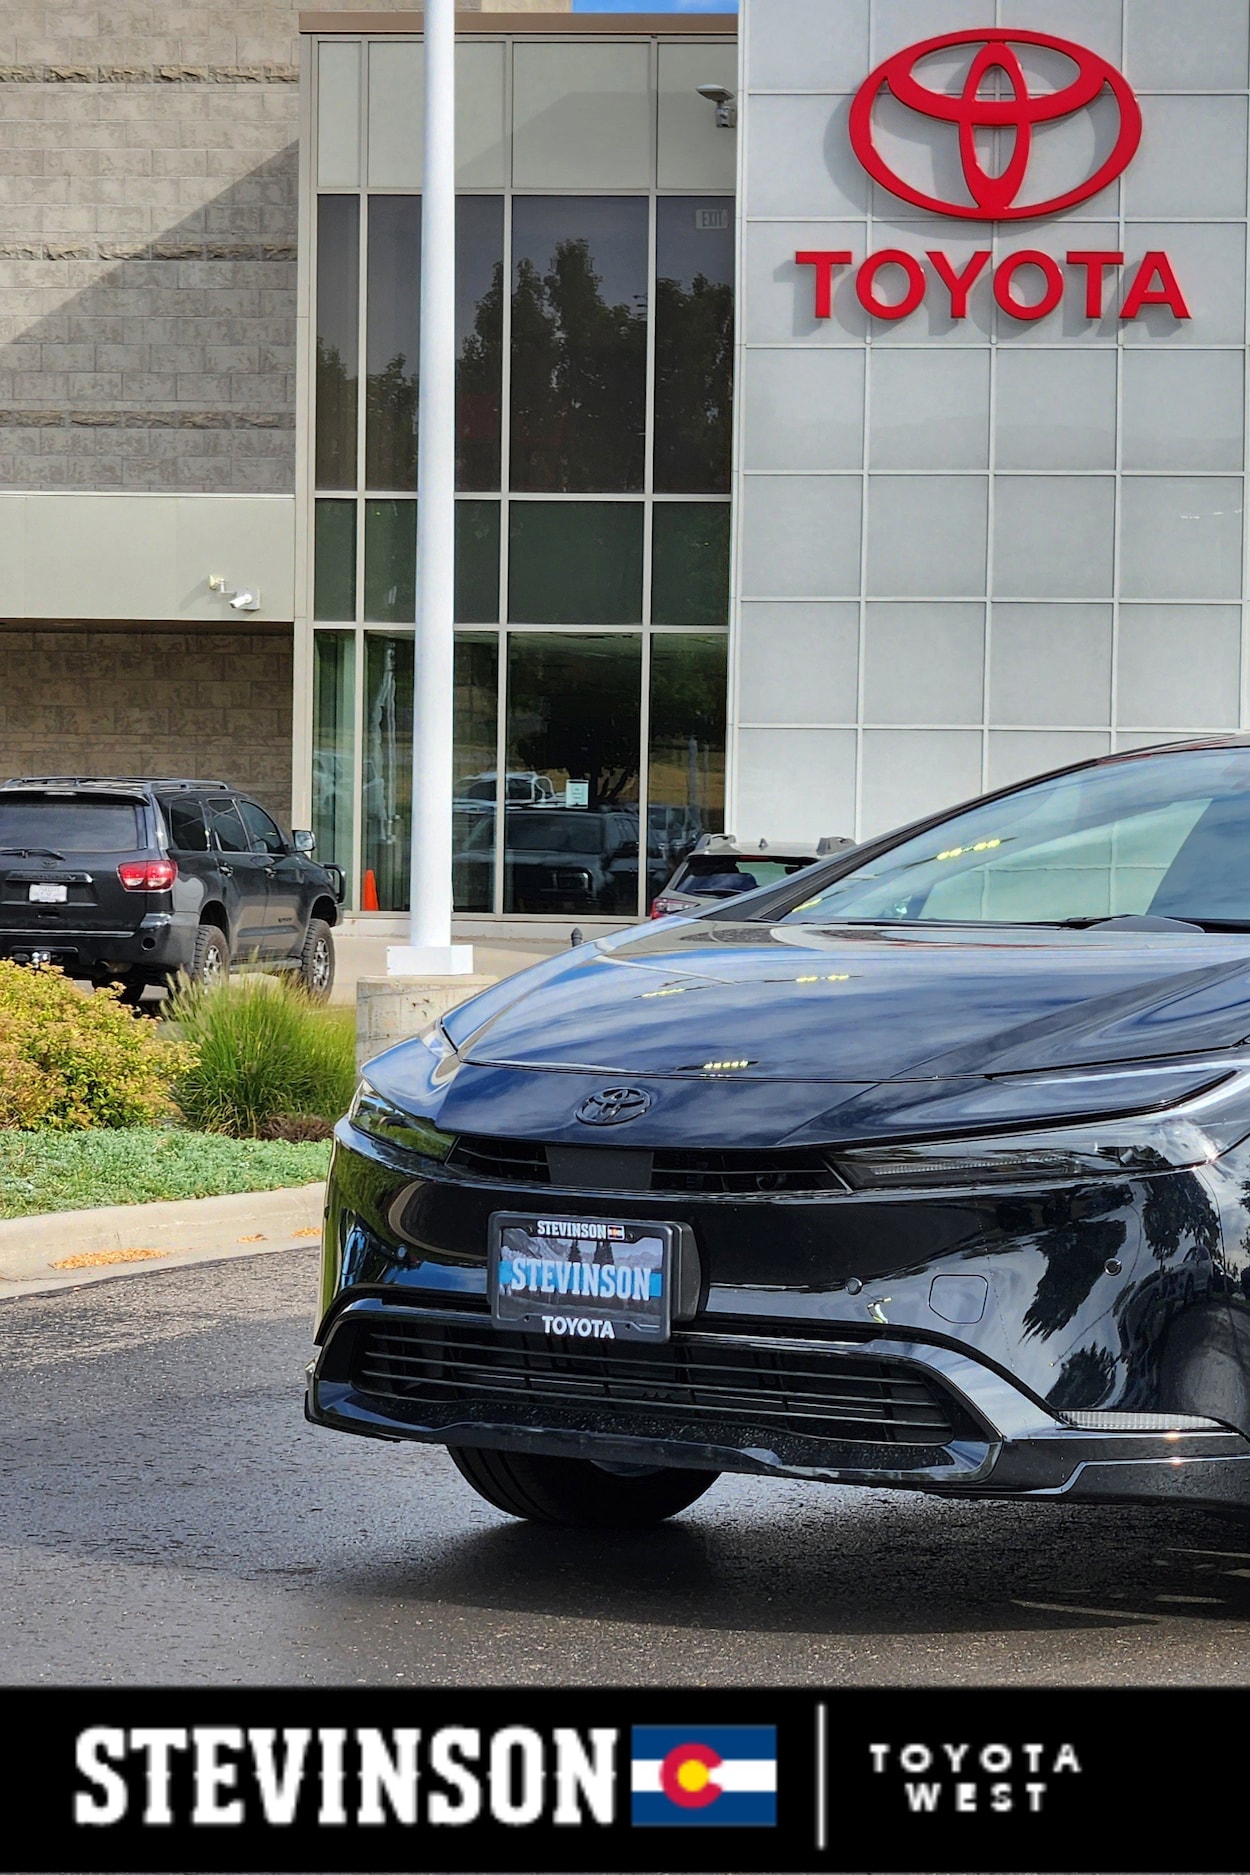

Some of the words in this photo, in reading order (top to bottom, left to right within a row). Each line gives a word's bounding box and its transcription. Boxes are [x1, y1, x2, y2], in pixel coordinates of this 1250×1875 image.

[795, 249, 1191, 320] TOYOTA
[537, 1220, 608, 1240] STEVINSON
[511, 1257, 651, 1301] STEVINSON
[541, 1315, 615, 1339] TOYOTA
